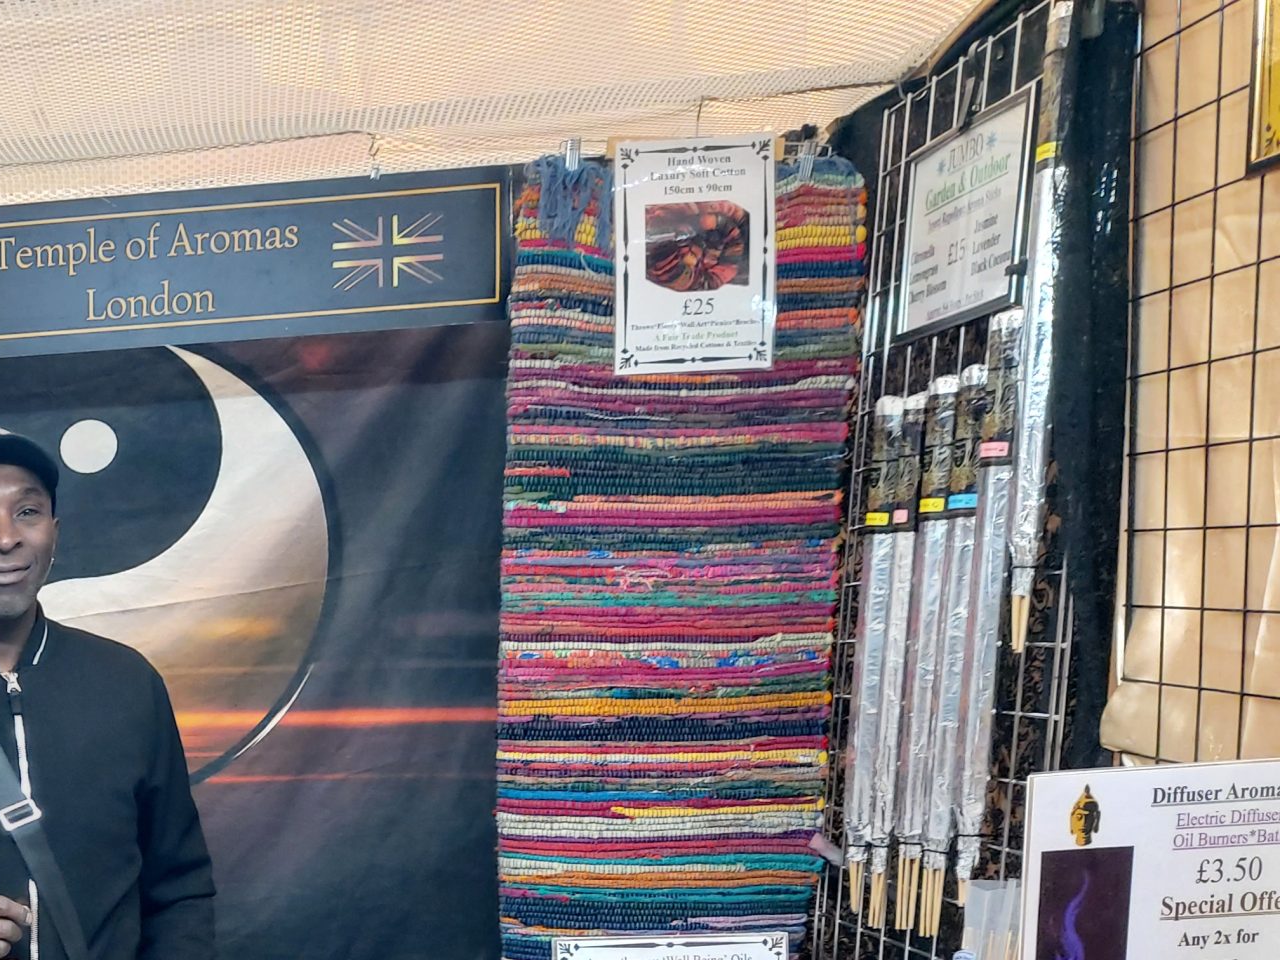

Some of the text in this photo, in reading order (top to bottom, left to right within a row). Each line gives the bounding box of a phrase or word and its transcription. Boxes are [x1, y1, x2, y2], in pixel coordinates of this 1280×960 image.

[667, 155, 731, 167] Hand Woven
[947, 133, 984, 172] JUMBO
[650, 166, 746, 182] Luxury Soft Cotton
[926, 182, 956, 211] Garden
[958, 171, 966, 194] &
[970, 153, 1011, 187] Outdoor
[664, 185, 695, 195] 150cm
[705, 183, 733, 193] 90cm
[125, 222, 162, 261] of
[167, 222, 300, 258] Aromas
[948, 238, 966, 266] £15
[85, 279, 216, 322] London
[682, 297, 715, 316] £25
[1151, 786, 1223, 805] Diffuser
[1176, 811, 1226, 828] Electric
[1173, 833, 1194, 848] Oil
[1195, 856, 1263, 884] £3.50
[1161, 893, 1233, 920] Special
[1177, 928, 1259, 949] Any 2x for
